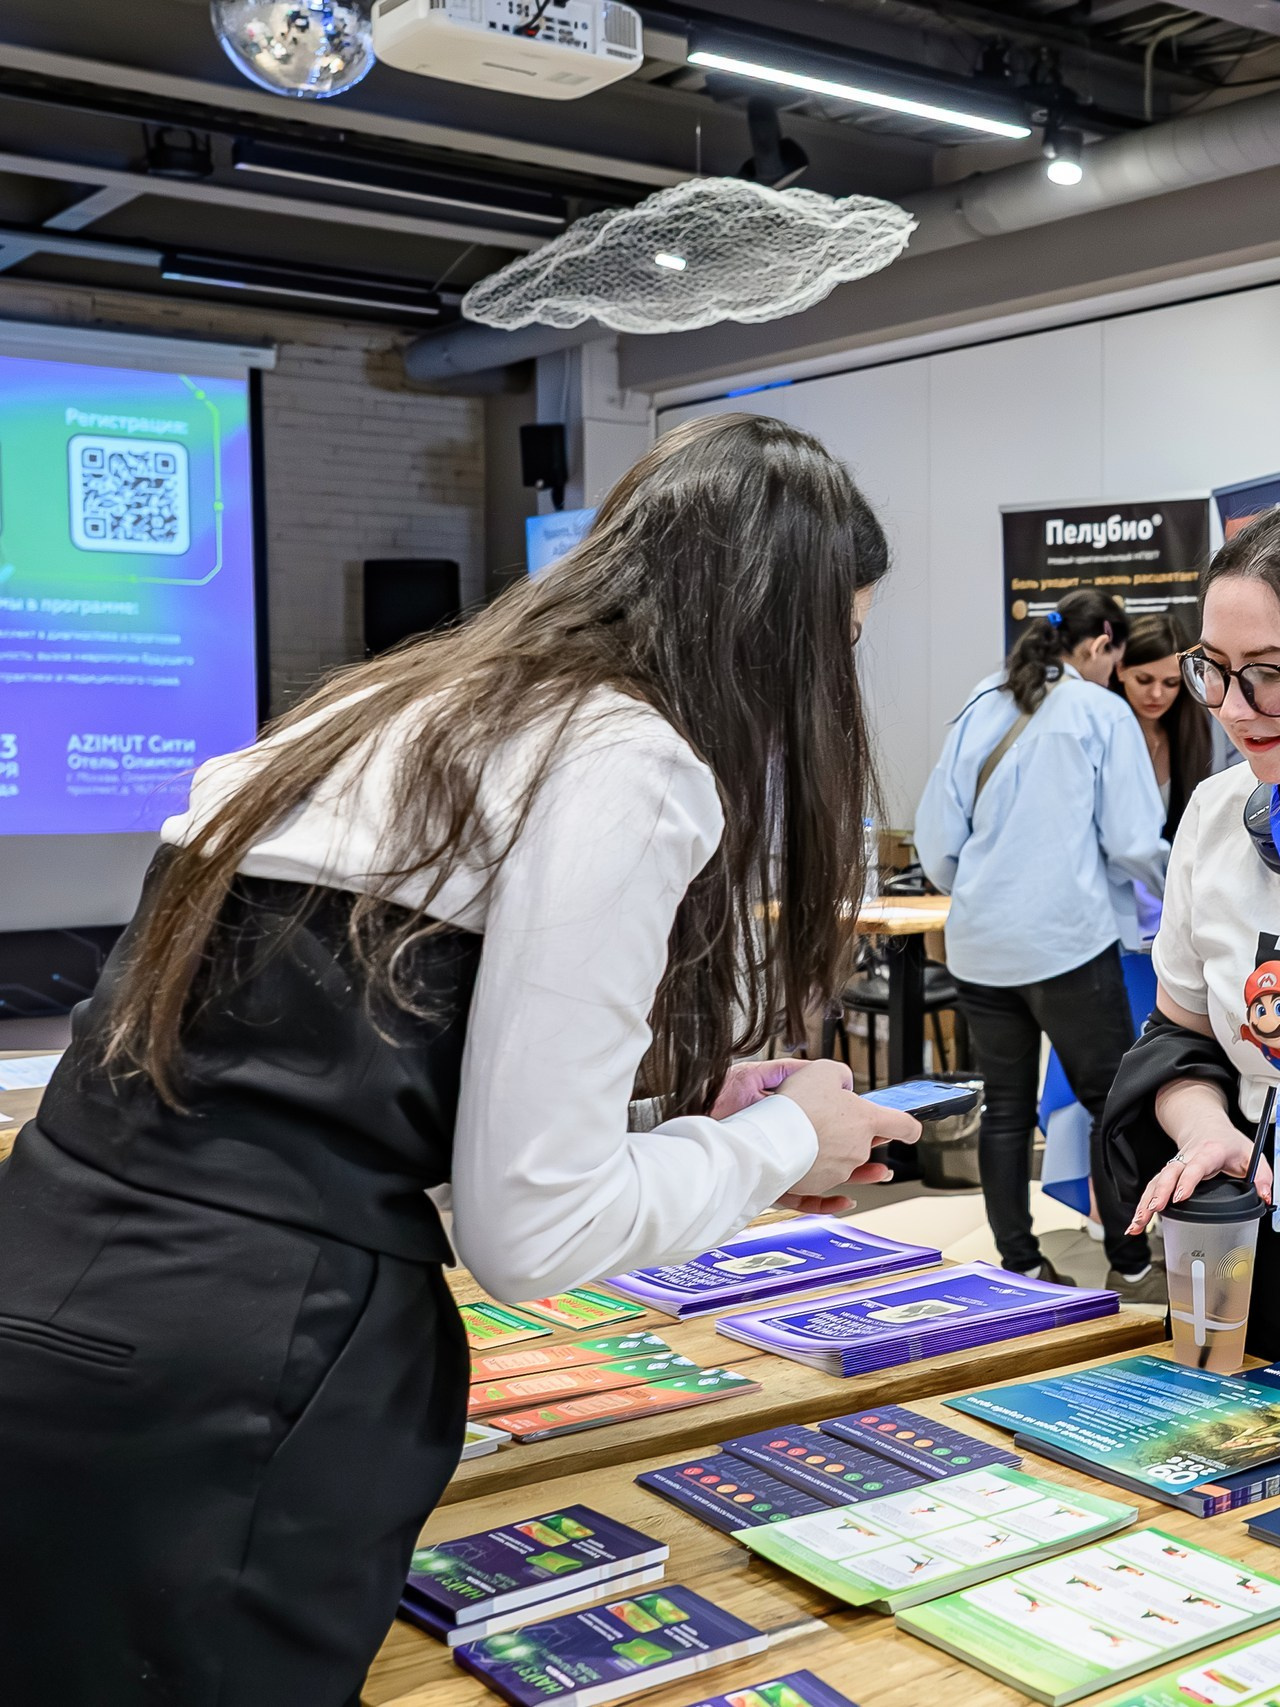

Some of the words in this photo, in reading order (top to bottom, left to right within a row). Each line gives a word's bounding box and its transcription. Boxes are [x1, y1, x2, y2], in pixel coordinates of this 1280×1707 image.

[65, 406, 189, 435] Регистрация:
[66, 733, 146, 753] AZIMUT
[148, 735, 196, 753] Сити
[1147, 1461, 1199, 1486] 09
